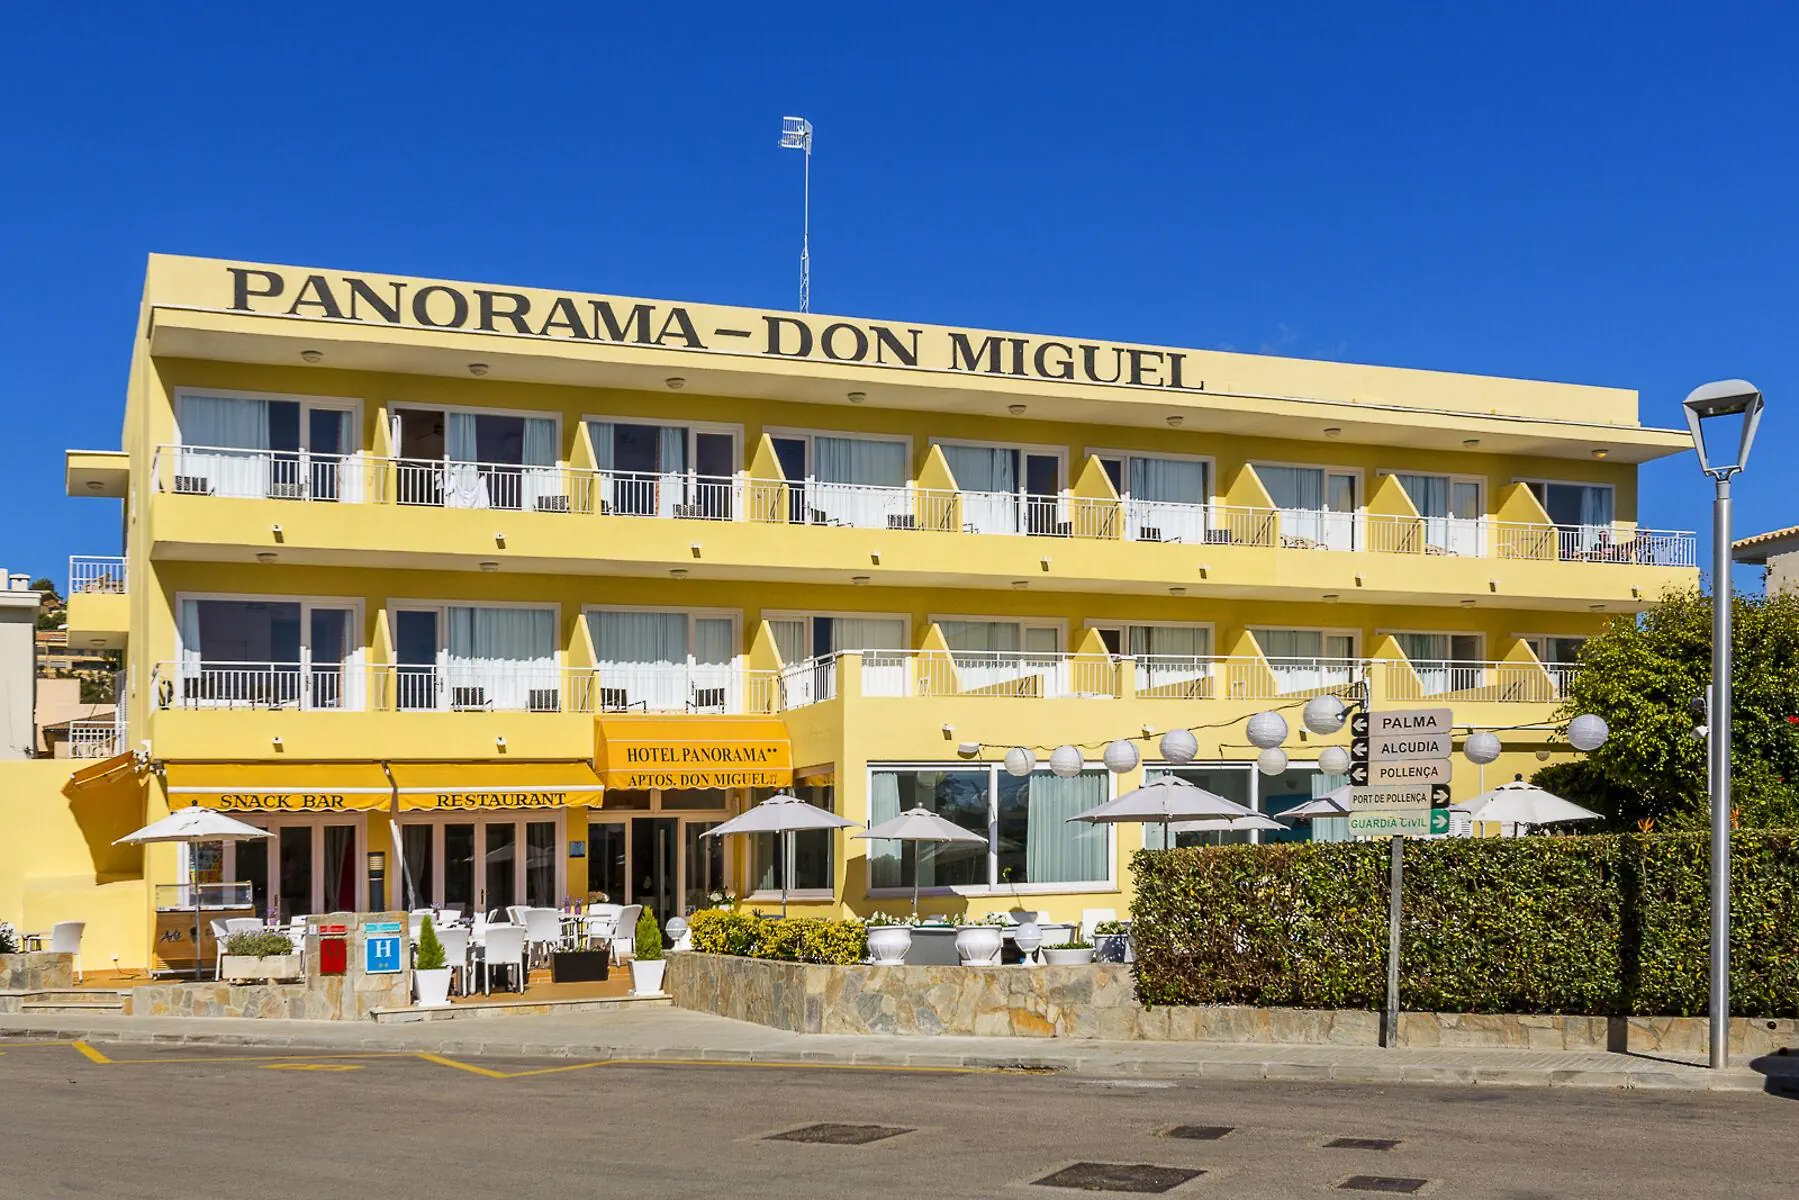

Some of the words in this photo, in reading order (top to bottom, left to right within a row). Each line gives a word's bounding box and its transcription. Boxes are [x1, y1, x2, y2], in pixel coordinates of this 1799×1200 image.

[226, 267, 708, 349] PANORAMA
[762, 315, 923, 367] DON
[947, 332, 1205, 391] MIGUEL
[1382, 715, 1437, 729] PALMA
[628, 747, 680, 762] HOTEL
[1381, 741, 1439, 754] ALCUDIA
[1380, 766, 1439, 779] POLLENÇA
[628, 774, 677, 787] APTOS.
[680, 774, 710, 786] DON
[713, 773, 769, 786] MIGUEL
[220, 794, 293, 808] SNACK
[302, 794, 344, 808] BAR
[436, 793, 567, 807] RESTAURANT
[1352, 794, 1373, 804] PORT
[1375, 794, 1385, 804] DE
[1386, 792, 1427, 804] POLLENÇA
[1351, 818, 1397, 829] GUARDIA
[1400, 817, 1427, 828] CIVIL
[375, 939, 392, 958] H
